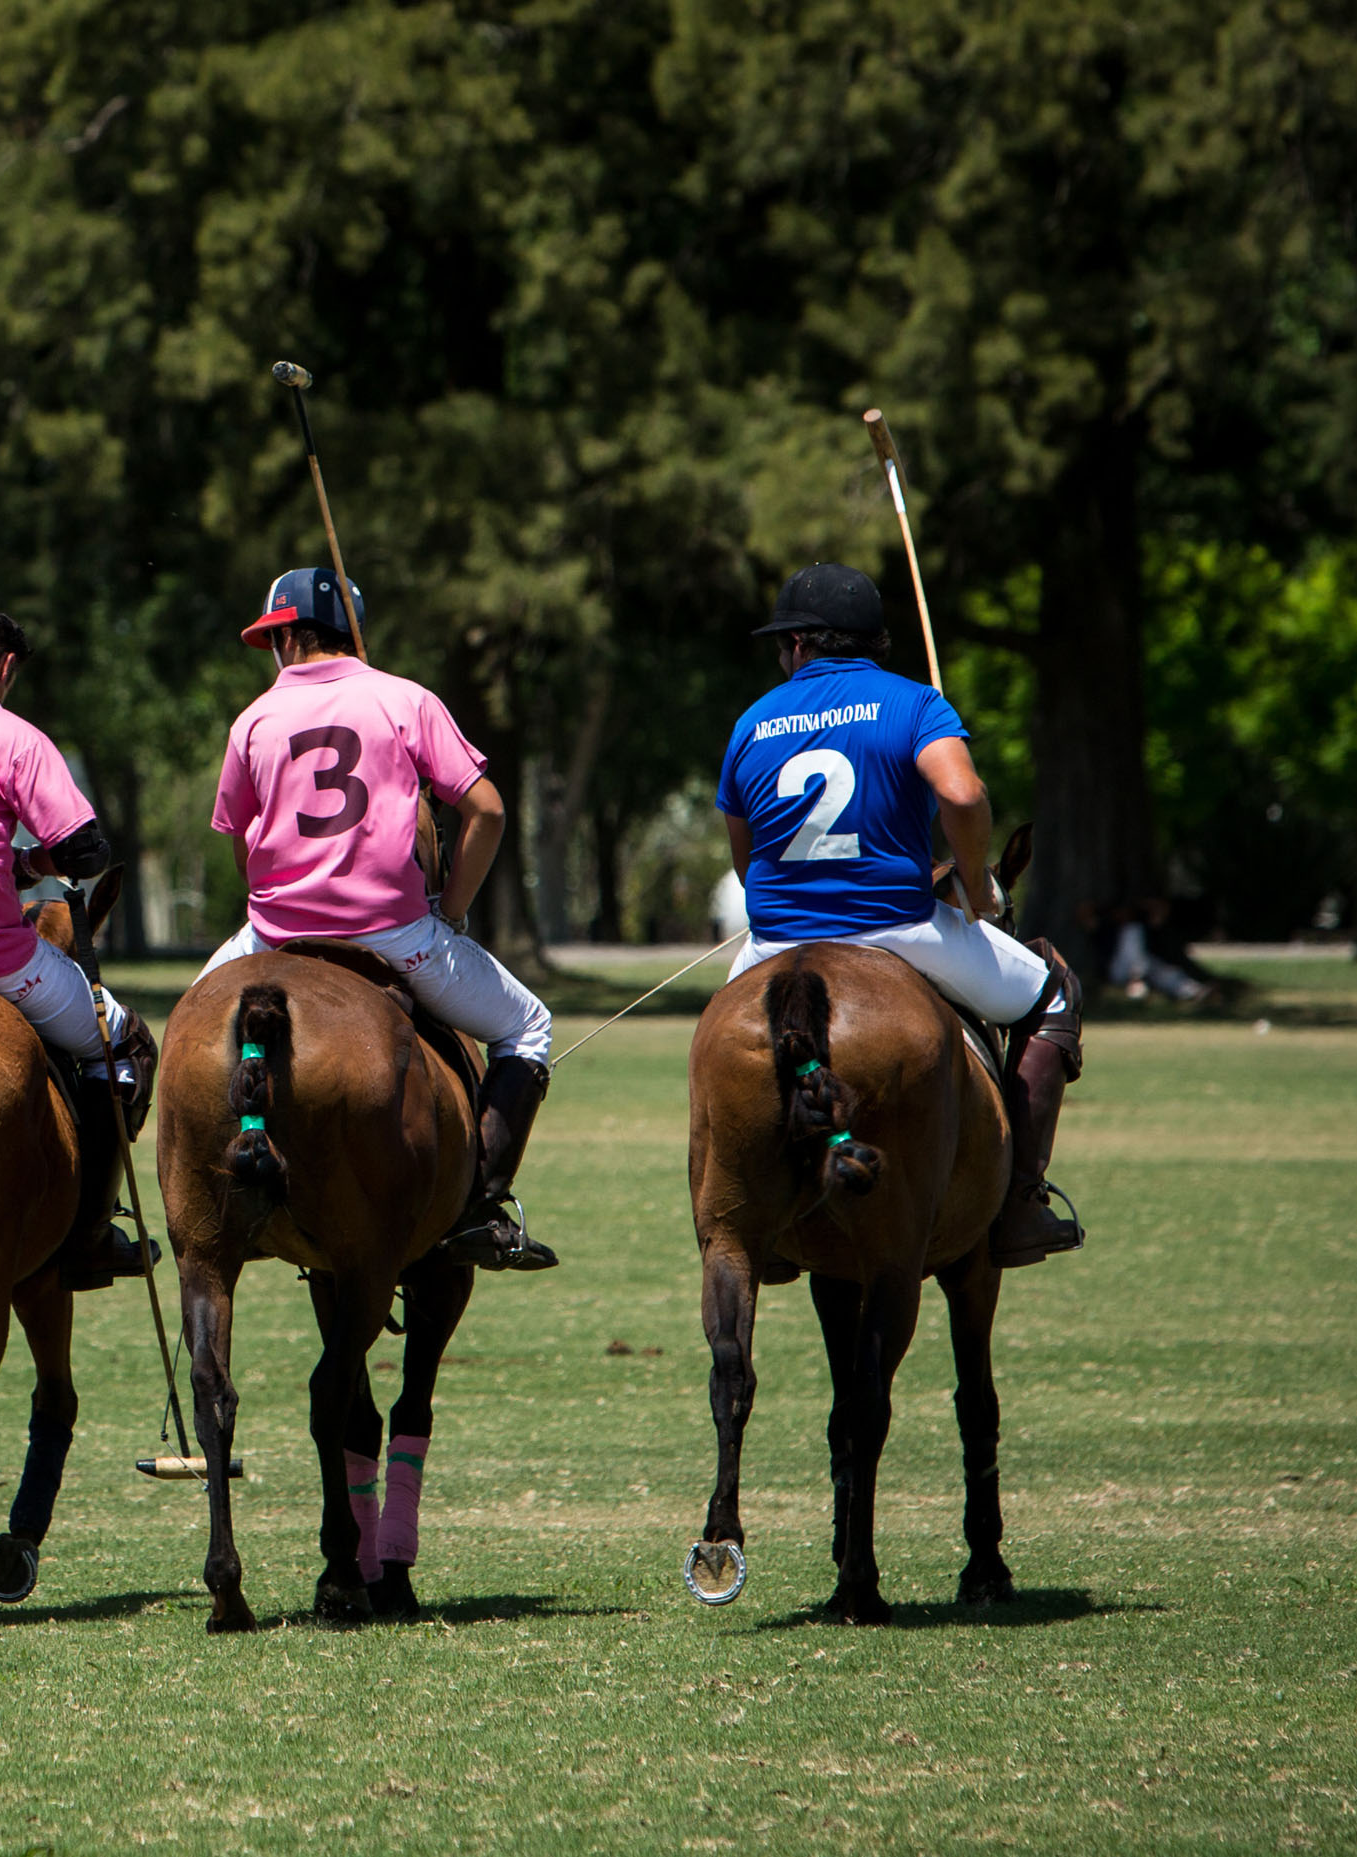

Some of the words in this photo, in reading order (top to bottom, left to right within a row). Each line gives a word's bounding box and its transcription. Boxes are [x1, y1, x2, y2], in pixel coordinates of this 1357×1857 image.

[753, 713, 820, 742] ARGENTINA
[820, 705, 853, 728] POLO
[854, 703, 881, 722] DAY
[289, 725, 369, 838] 3
[777, 748, 860, 861] 2
